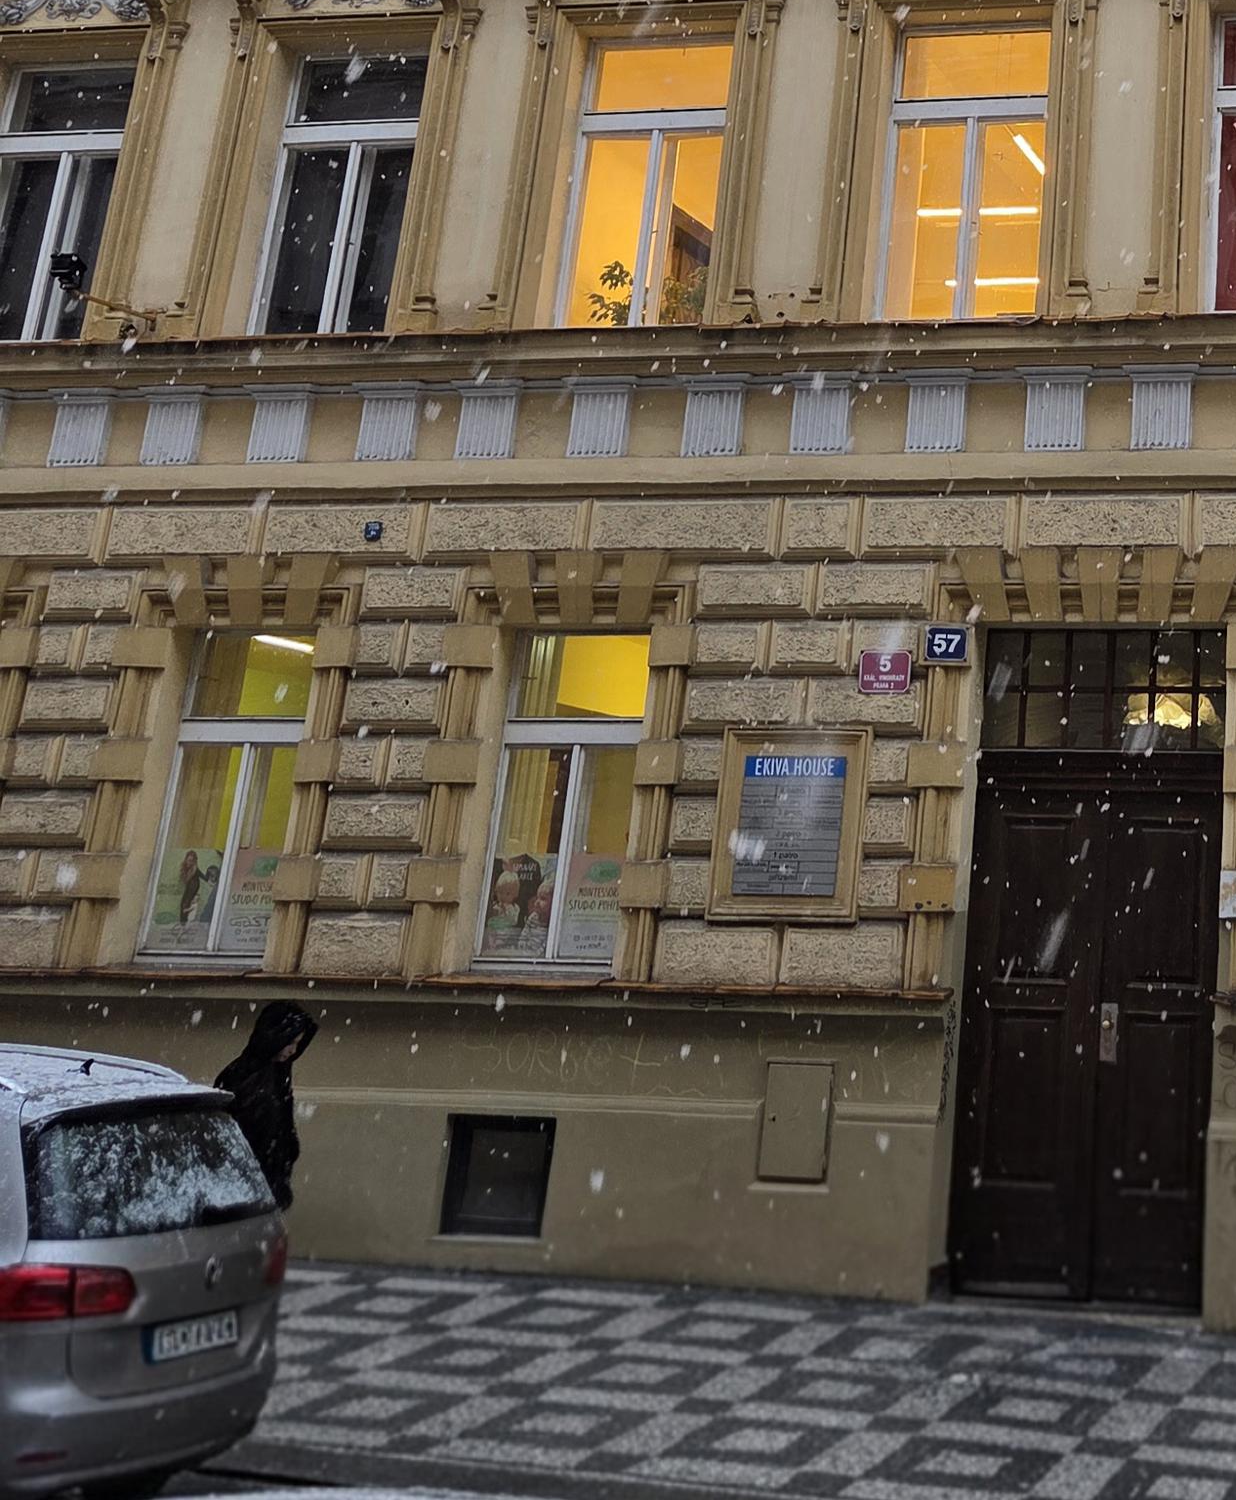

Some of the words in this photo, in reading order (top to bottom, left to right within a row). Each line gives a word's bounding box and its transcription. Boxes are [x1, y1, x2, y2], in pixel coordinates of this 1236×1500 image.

[932, 633, 961, 654] 57
[879, 655, 892, 672] 5
[755, 758, 790, 776] EKIVA
[793, 758, 835, 776] HOUSE
[577, 886, 619, 898] MONTESSOR
[568, 899, 596, 911] STUDIO
